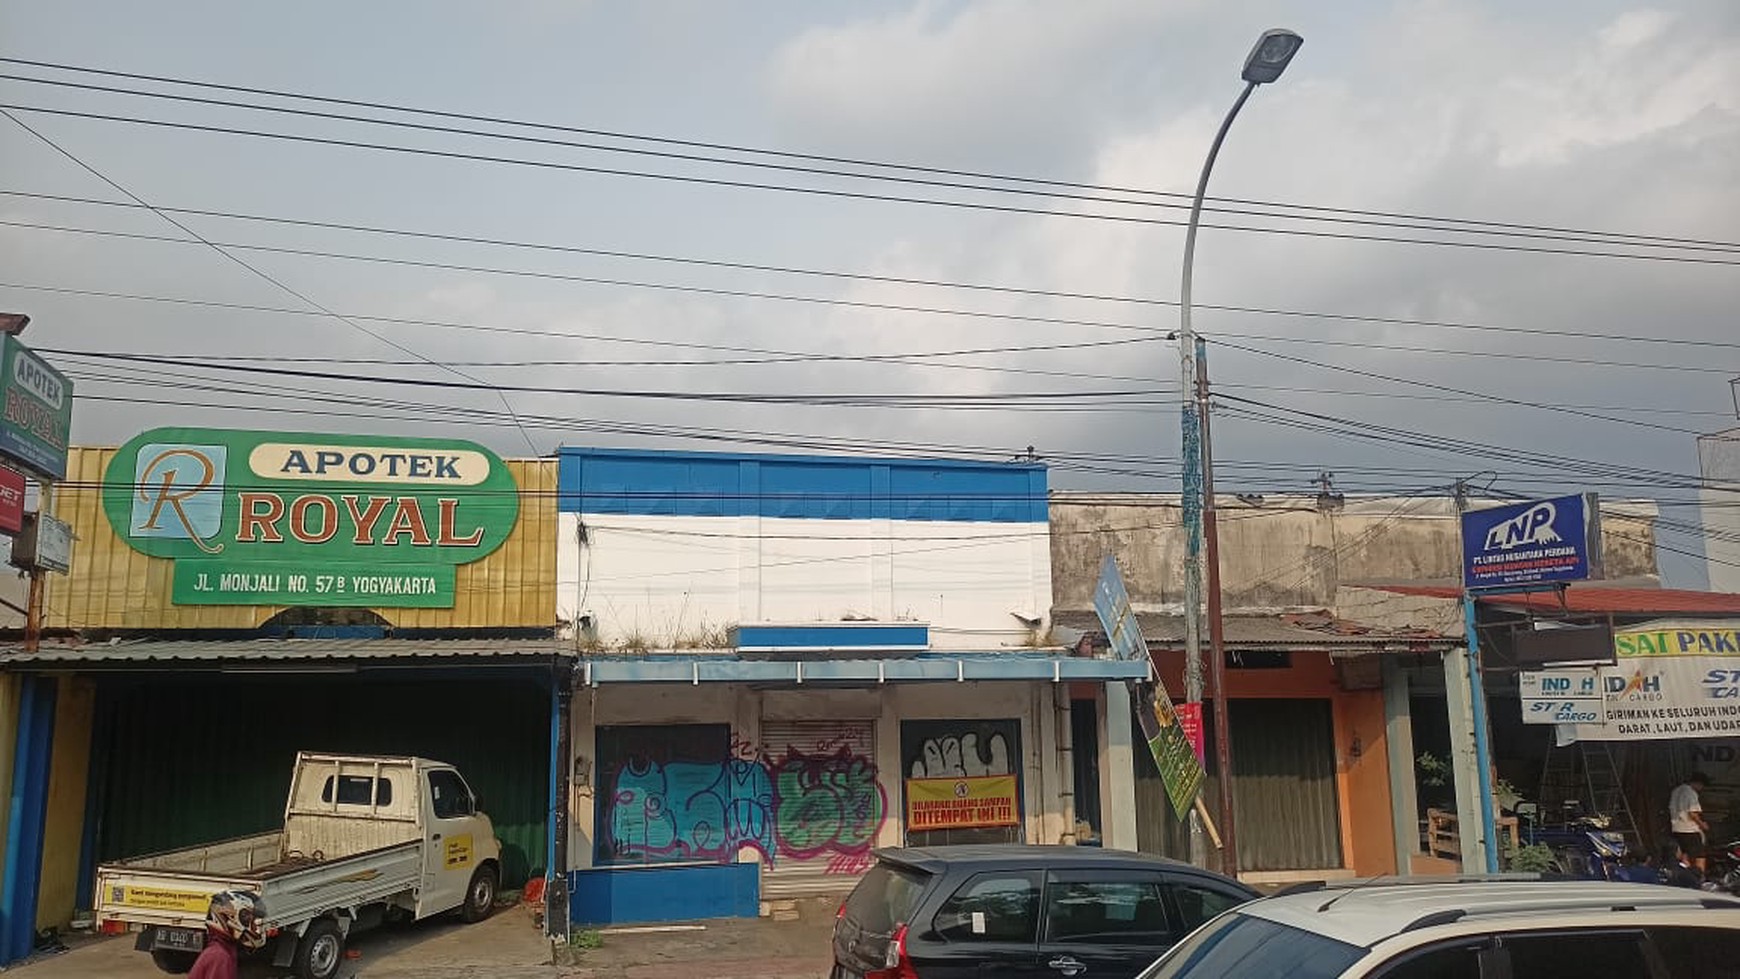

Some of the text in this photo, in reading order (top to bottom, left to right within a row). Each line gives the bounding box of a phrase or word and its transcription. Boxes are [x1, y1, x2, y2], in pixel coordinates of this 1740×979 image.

[17, 359, 60, 402] APOTEK
[5, 386, 65, 452] ROYAL
[280, 449, 462, 479] APOTEK
[235, 491, 486, 548] ROYAL
[1484, 502, 1562, 550] LNP
[193, 574, 214, 591] JL.
[220, 574, 280, 592] MONJALI
[288, 575, 309, 593] NO.
[352, 577, 437, 594] YOGYAKARTA
[1652, 708, 1665, 719] KE
[1666, 706, 1717, 719] SELURUH
[1689, 721, 1712, 732] DAN
[913, 808, 974, 825] DITEMPAT
[977, 806, 994, 822] INI
